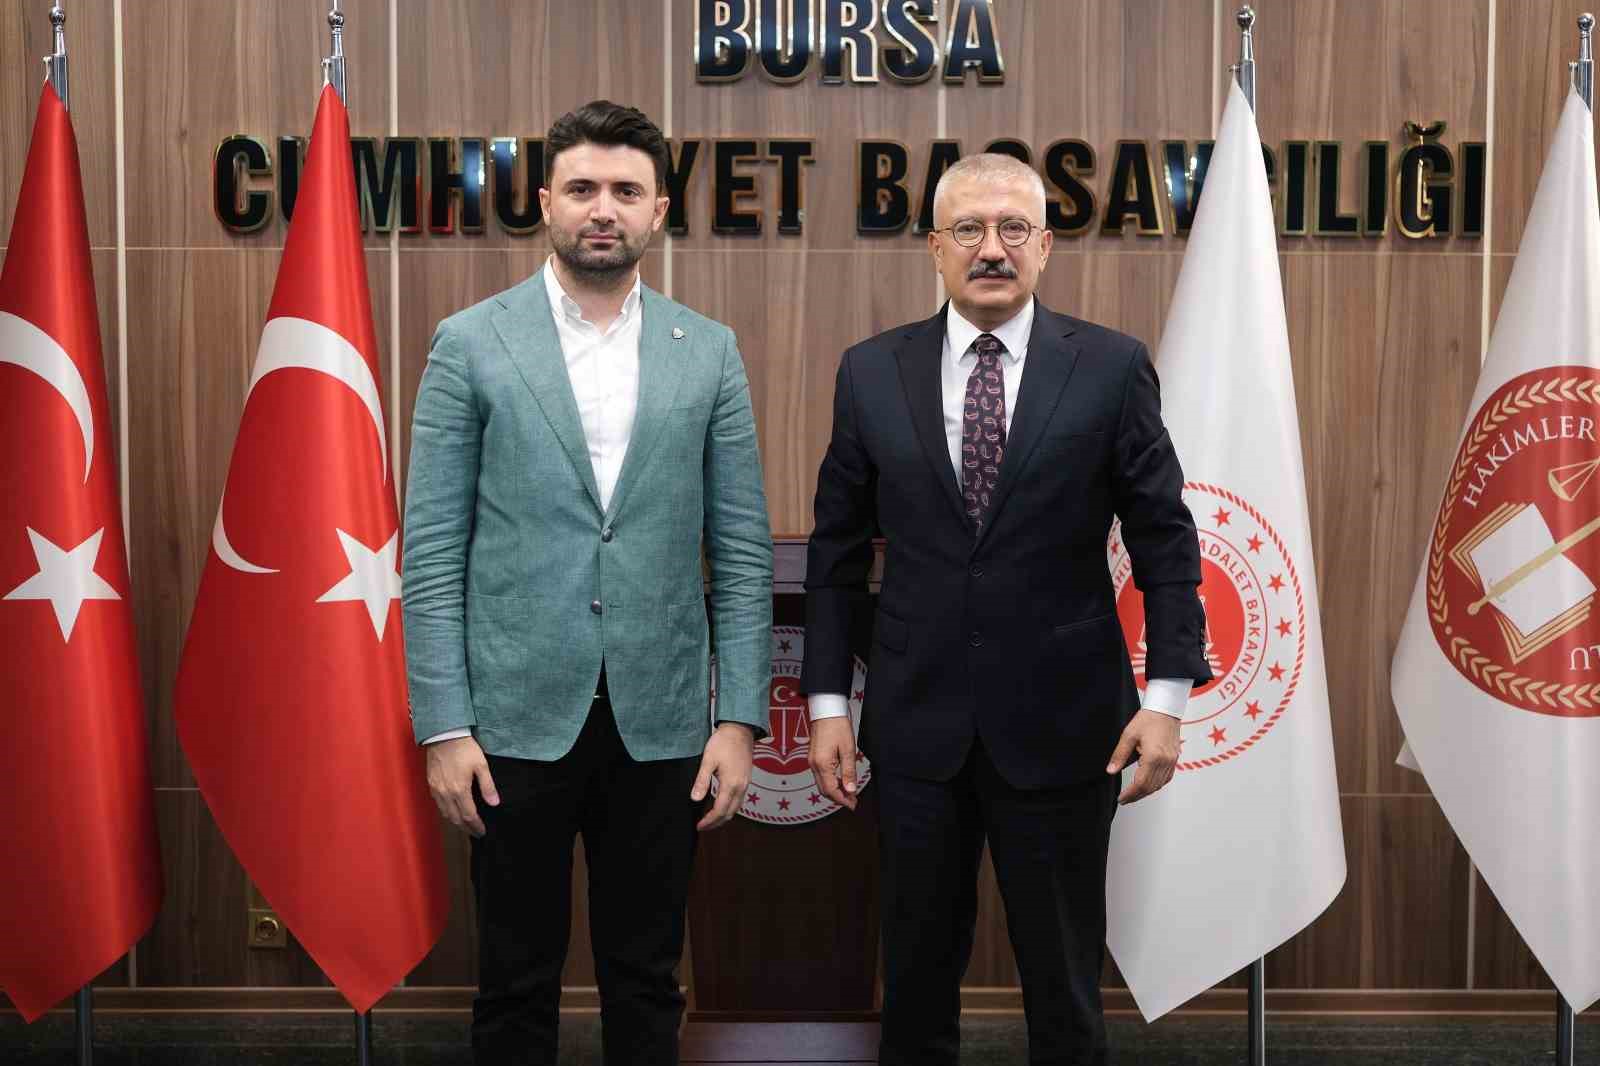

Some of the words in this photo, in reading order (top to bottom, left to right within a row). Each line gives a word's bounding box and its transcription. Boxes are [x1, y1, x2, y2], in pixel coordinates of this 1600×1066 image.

[694, 0, 1005, 84] BURSA
[857, 121, 1488, 240] BASAVILIĞI
[1463, 416, 1596, 507] HÂKİMLER
